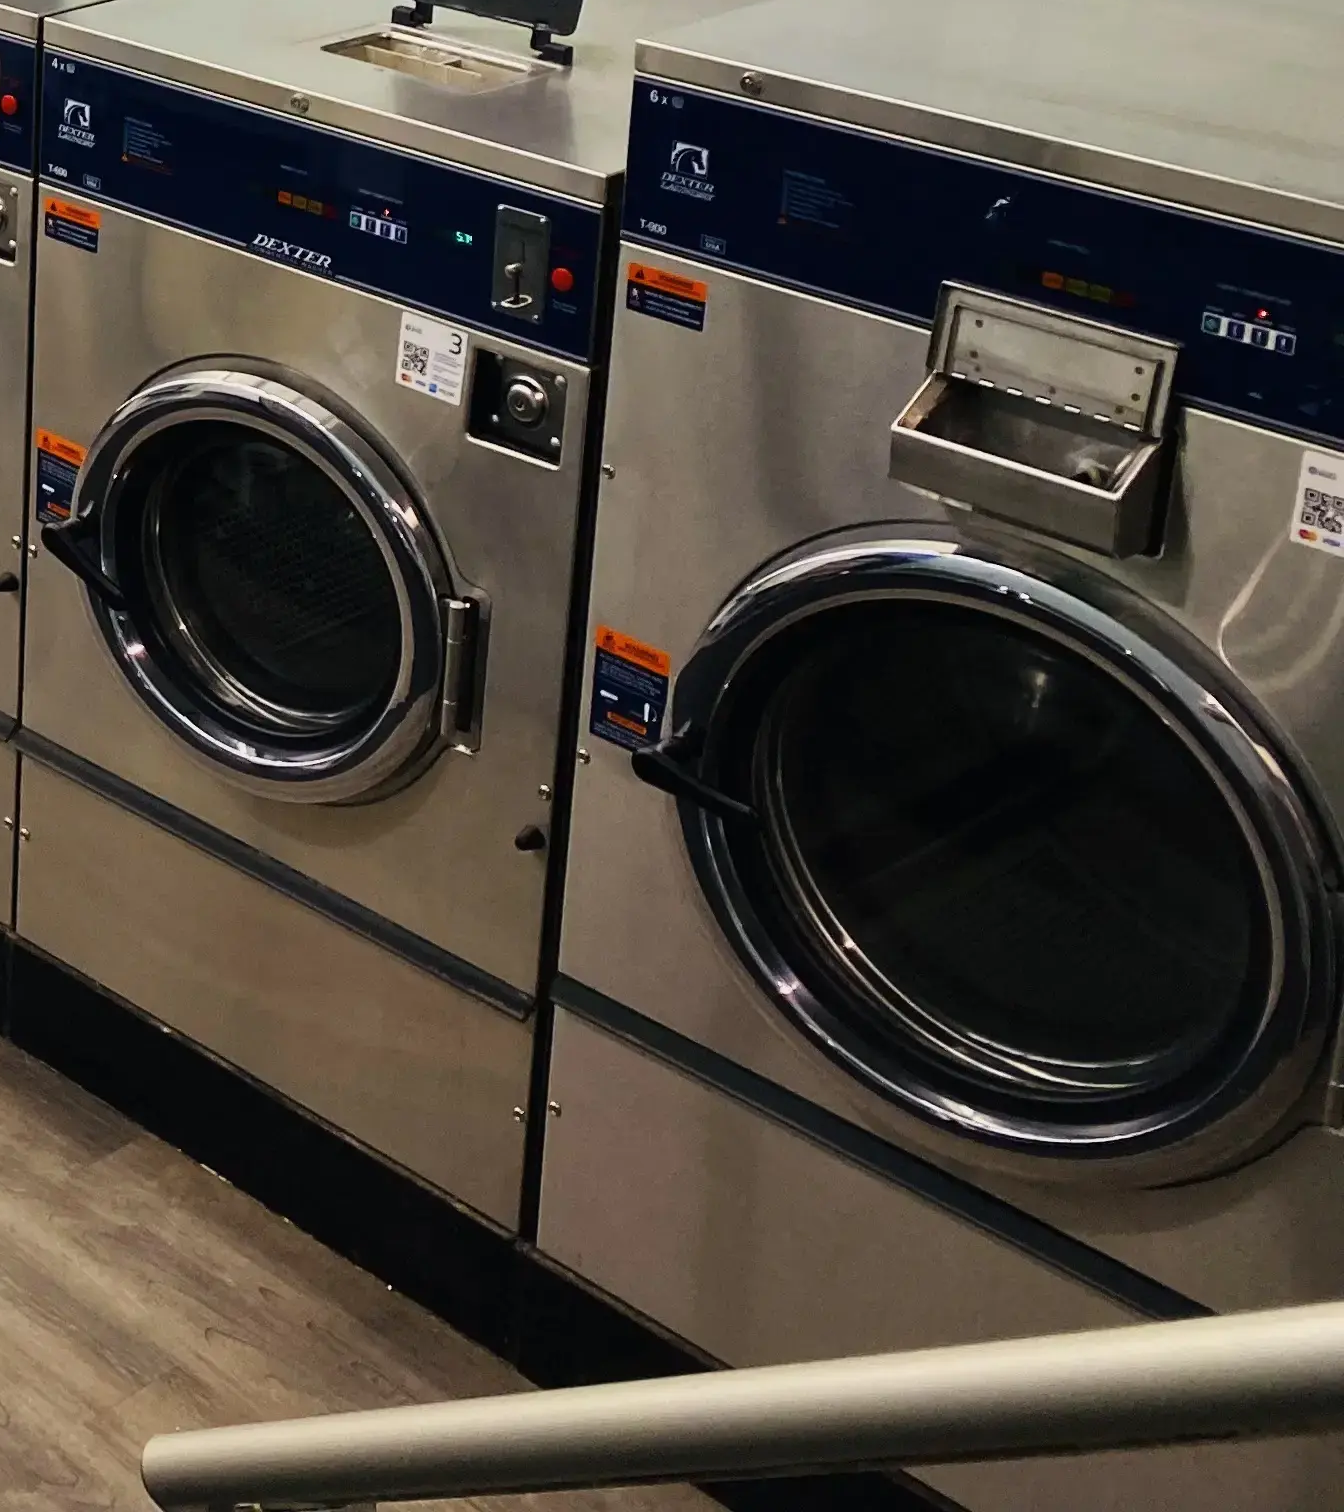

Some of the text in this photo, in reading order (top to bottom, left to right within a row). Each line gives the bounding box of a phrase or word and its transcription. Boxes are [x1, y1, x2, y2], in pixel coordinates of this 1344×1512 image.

[52, 57, 58, 69] 4
[649, 90, 659, 103] 6
[661, 171, 715, 193] DEXTER
[252, 233, 332, 268] DEXTER
[448, 332, 463, 356] 3
